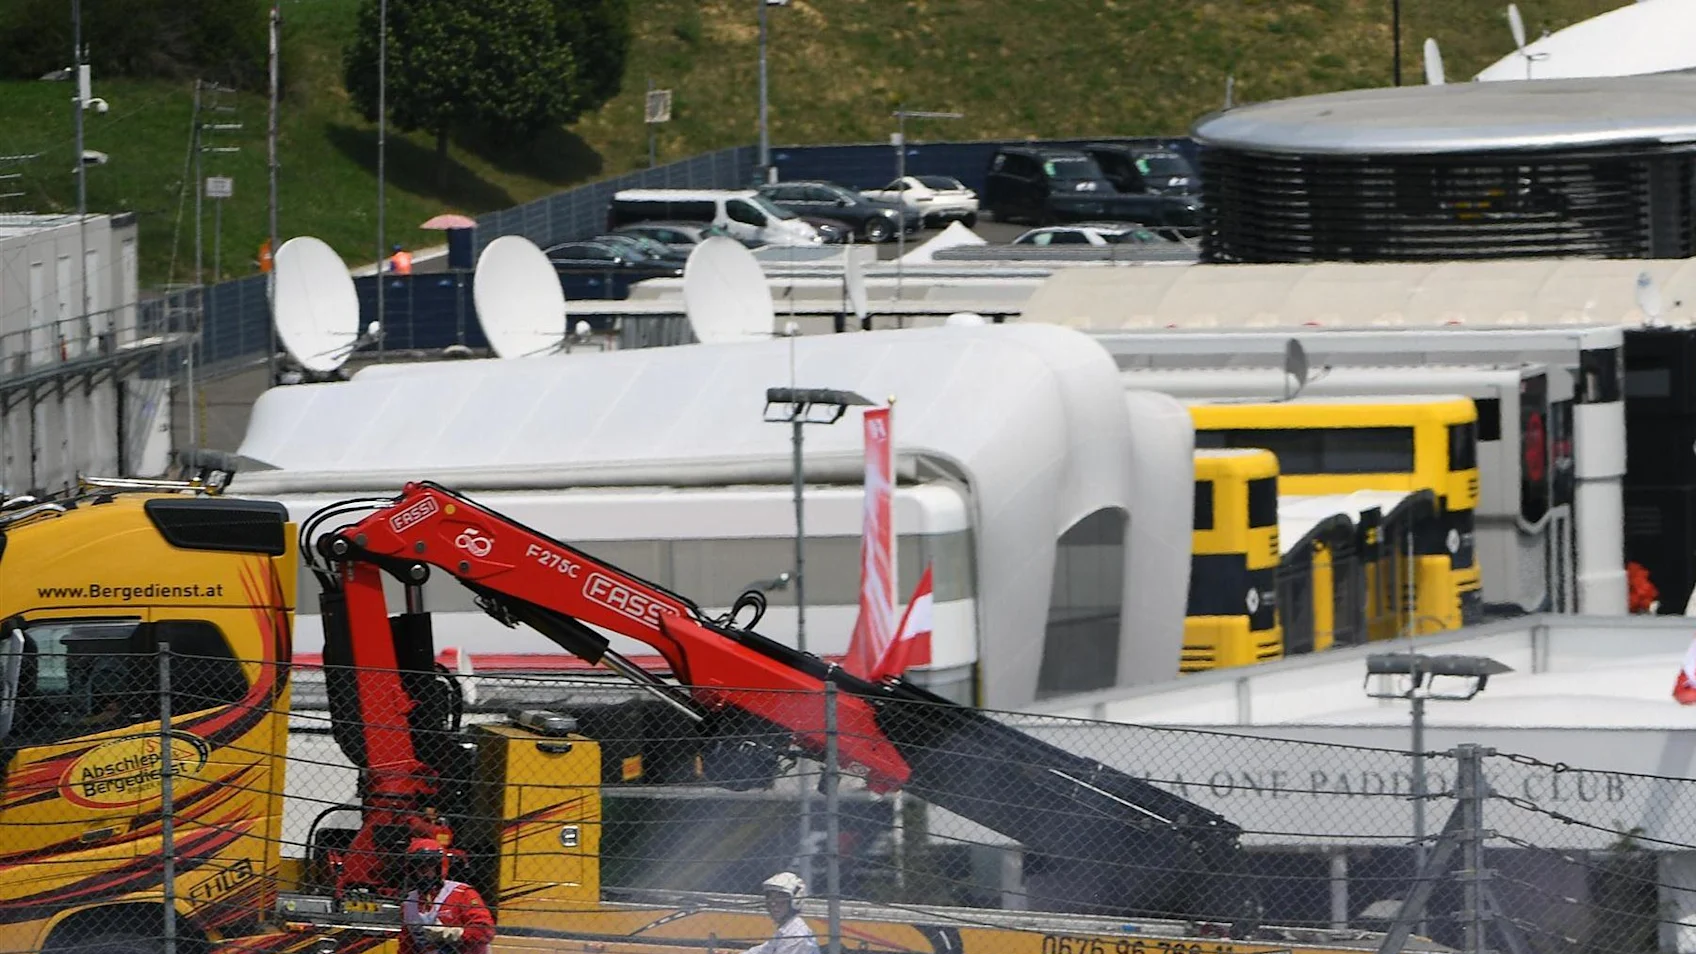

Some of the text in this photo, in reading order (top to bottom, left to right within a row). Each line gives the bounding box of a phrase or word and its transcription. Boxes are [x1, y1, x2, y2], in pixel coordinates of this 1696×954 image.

[393, 499, 435, 528] FASSI
[526, 544, 582, 579] F275C
[37, 583, 224, 601] www.Bergedienst.at
[589, 577, 673, 625] FASS
[81, 752, 161, 782] Abschlep
[1207, 770, 1291, 799] ONE
[1523, 773, 1626, 802] CLUB
